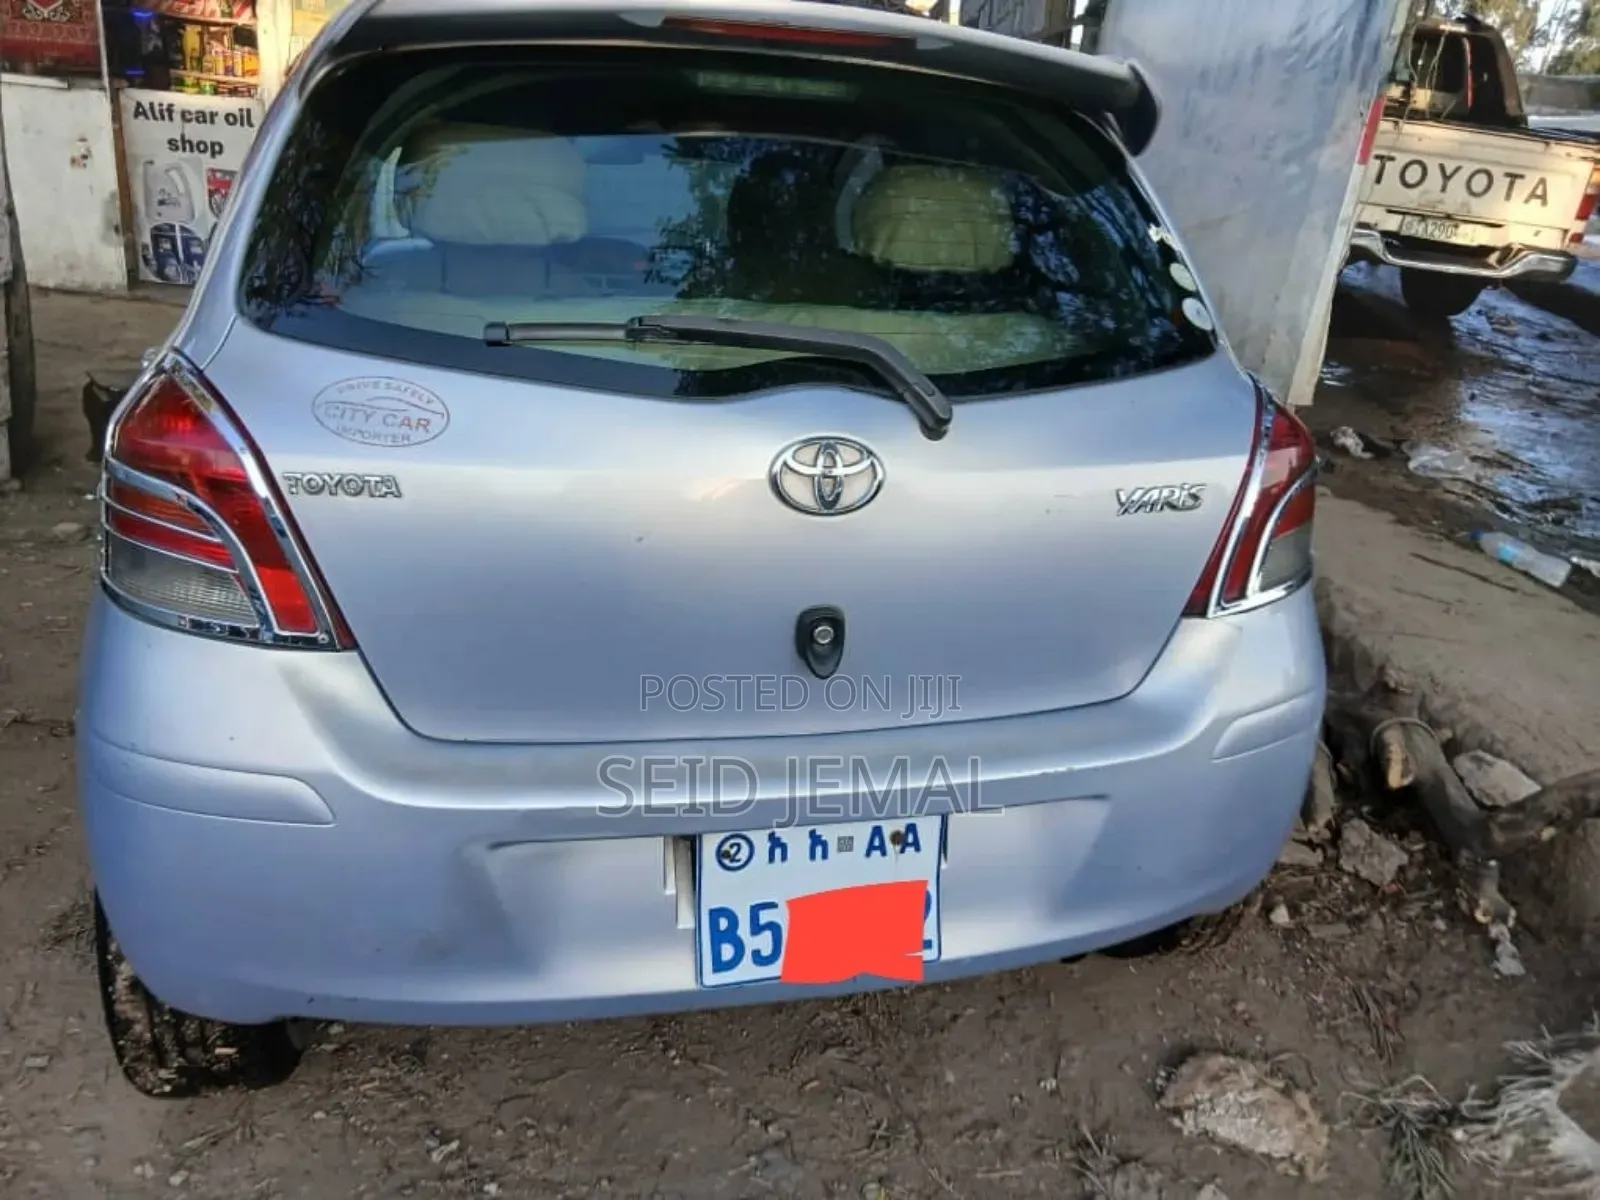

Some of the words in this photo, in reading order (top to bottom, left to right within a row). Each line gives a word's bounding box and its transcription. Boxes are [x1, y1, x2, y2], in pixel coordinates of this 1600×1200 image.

[133, 101, 175, 122] Alif
[181, 108, 219, 125] car
[224, 108, 255, 128] oil
[167, 133, 224, 159] shop
[1373, 154, 1549, 207] TOYOTA
[323, 404, 377, 423] CITY
[382, 413, 431, 433] CAR
[283, 472, 402, 498] TOYOTA
